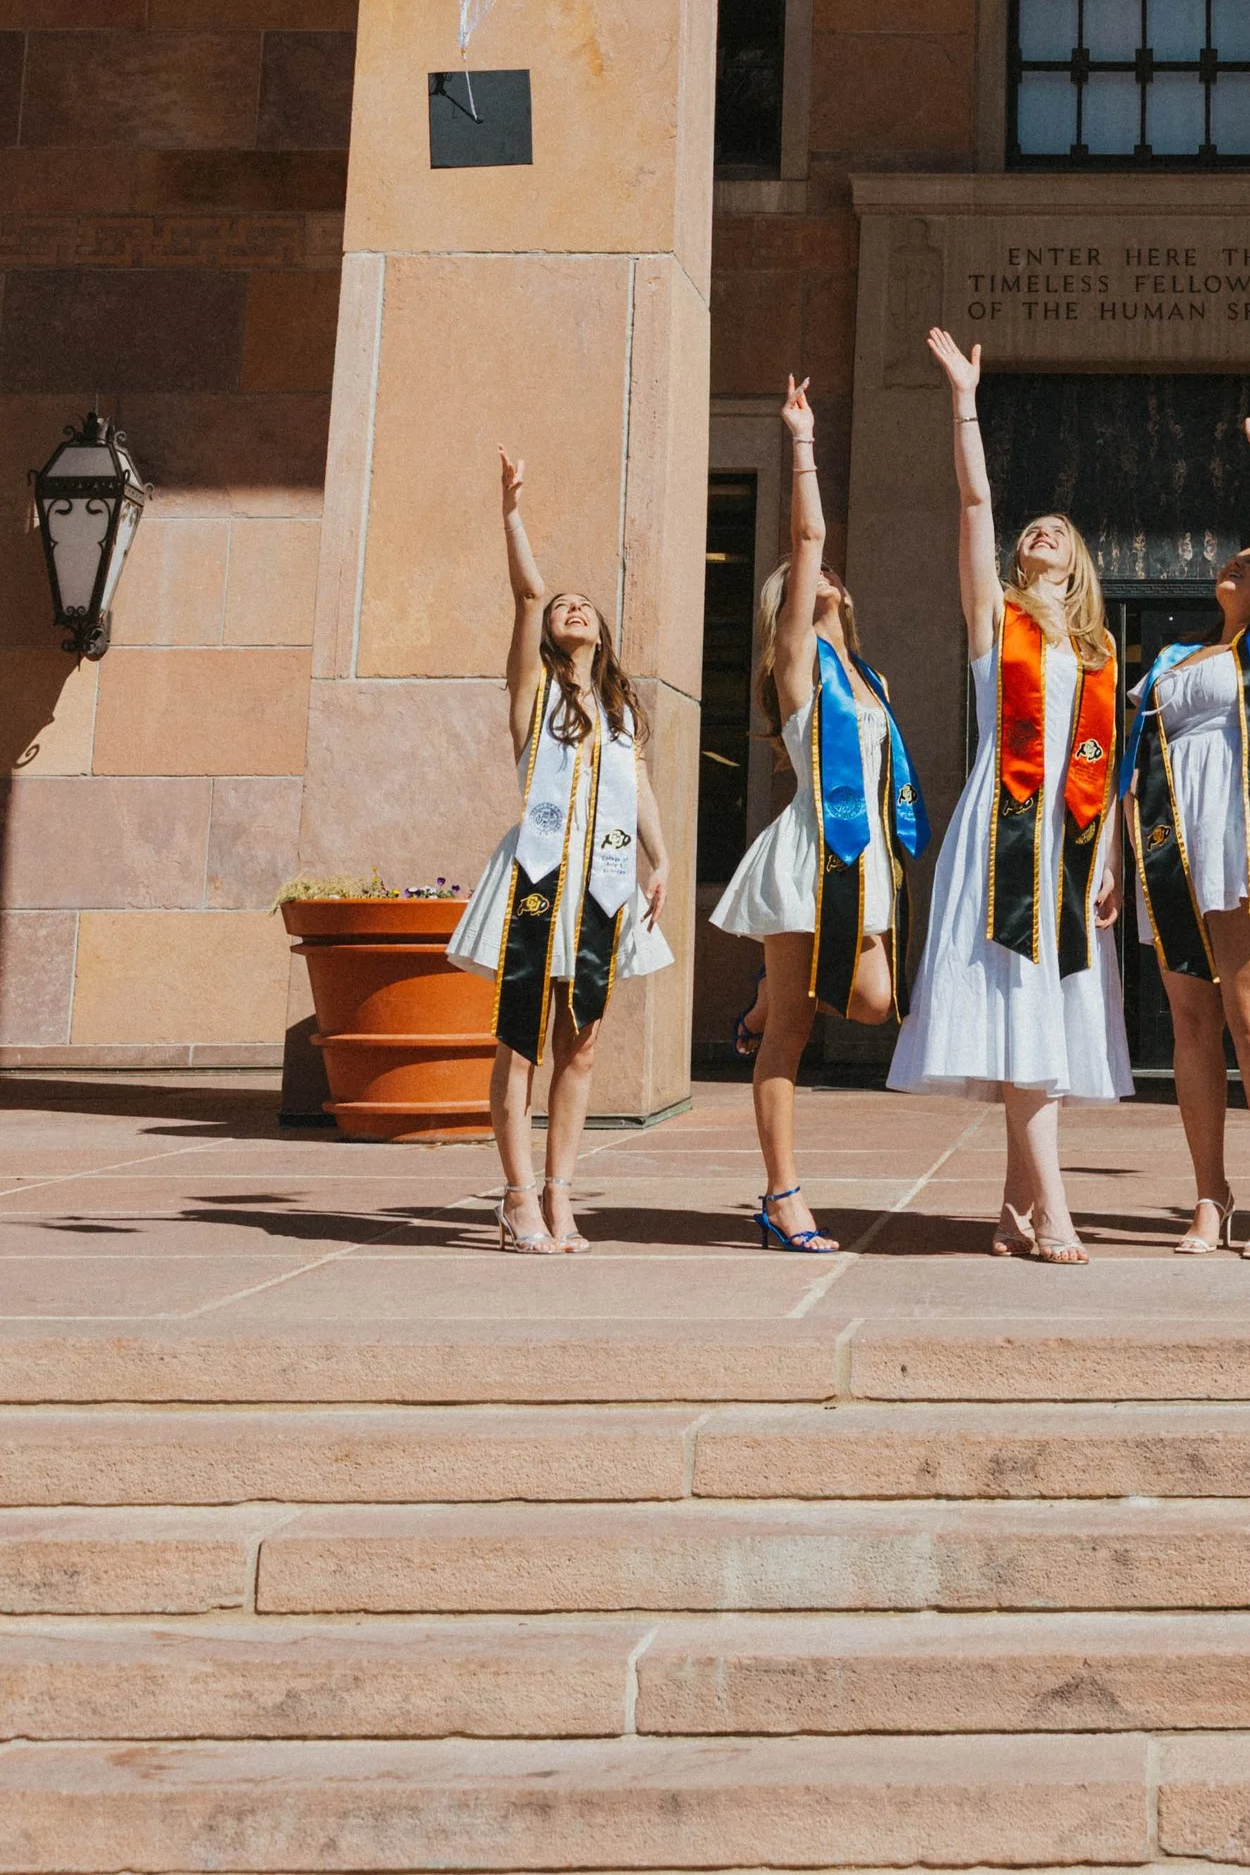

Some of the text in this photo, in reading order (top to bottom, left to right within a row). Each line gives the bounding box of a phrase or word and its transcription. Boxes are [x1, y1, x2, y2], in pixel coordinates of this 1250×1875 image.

[1008, 247, 1102, 267] ENTER
[1125, 247, 1197, 267] HERE
[968, 274, 1109, 294] TIMELESS
[967, 301, 1003, 321] OF
[1022, 301, 1079, 321] THE
[1099, 301, 1206, 321] HUMAN
